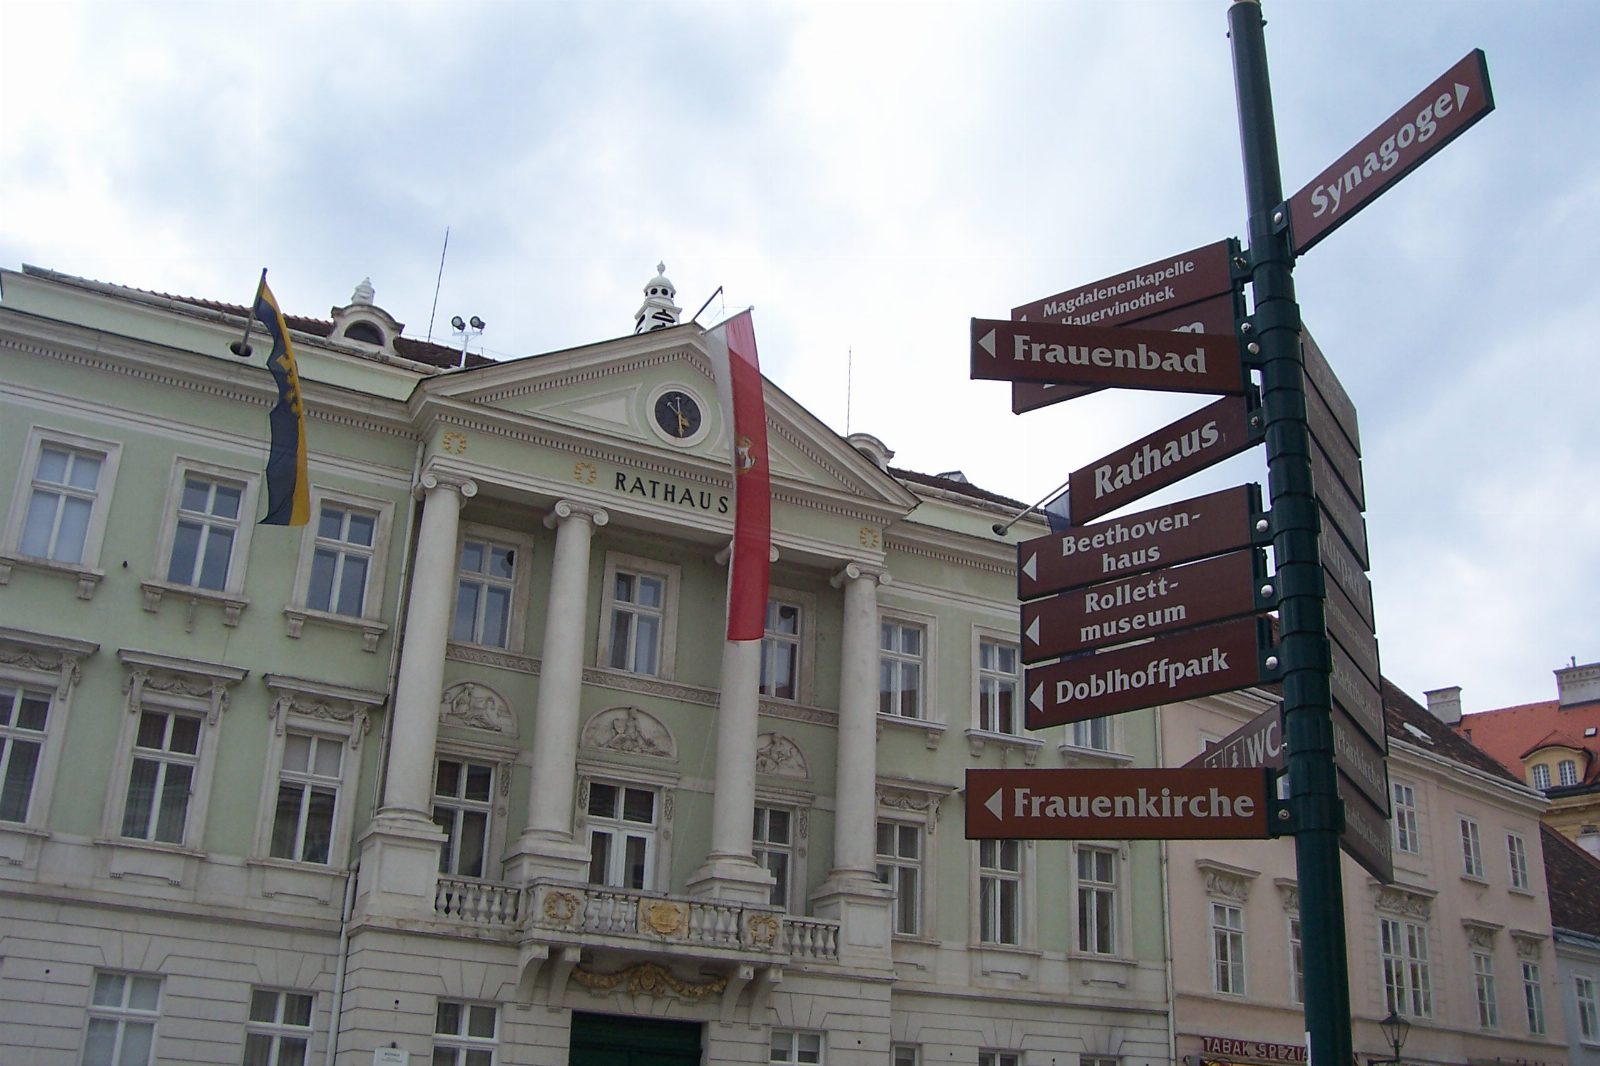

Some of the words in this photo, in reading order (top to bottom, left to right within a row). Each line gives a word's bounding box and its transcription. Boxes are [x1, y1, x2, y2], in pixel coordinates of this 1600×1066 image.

[1310, 92, 1453, 218] Synagoge
[1043, 259, 1195, 318] Magdalenenkapelle
[1061, 285, 1175, 325] Hauervinothek
[1013, 334, 1208, 375] Frauenbad
[1094, 420, 1219, 500] Rathaus
[615, 471, 729, 514] RATHAUS
[1062, 511, 1200, 557] Beethoven-
[1102, 545, 1161, 574] haus
[1085, 574, 1179, 614] Rollett-
[1080, 604, 1187, 643] museum
[1056, 647, 1230, 705] Doblhoffpark
[1246, 720, 1280, 768] WC
[1014, 787, 1255, 818] Frauenkirche
[1203, 1037, 1250, 1056] TABAK
